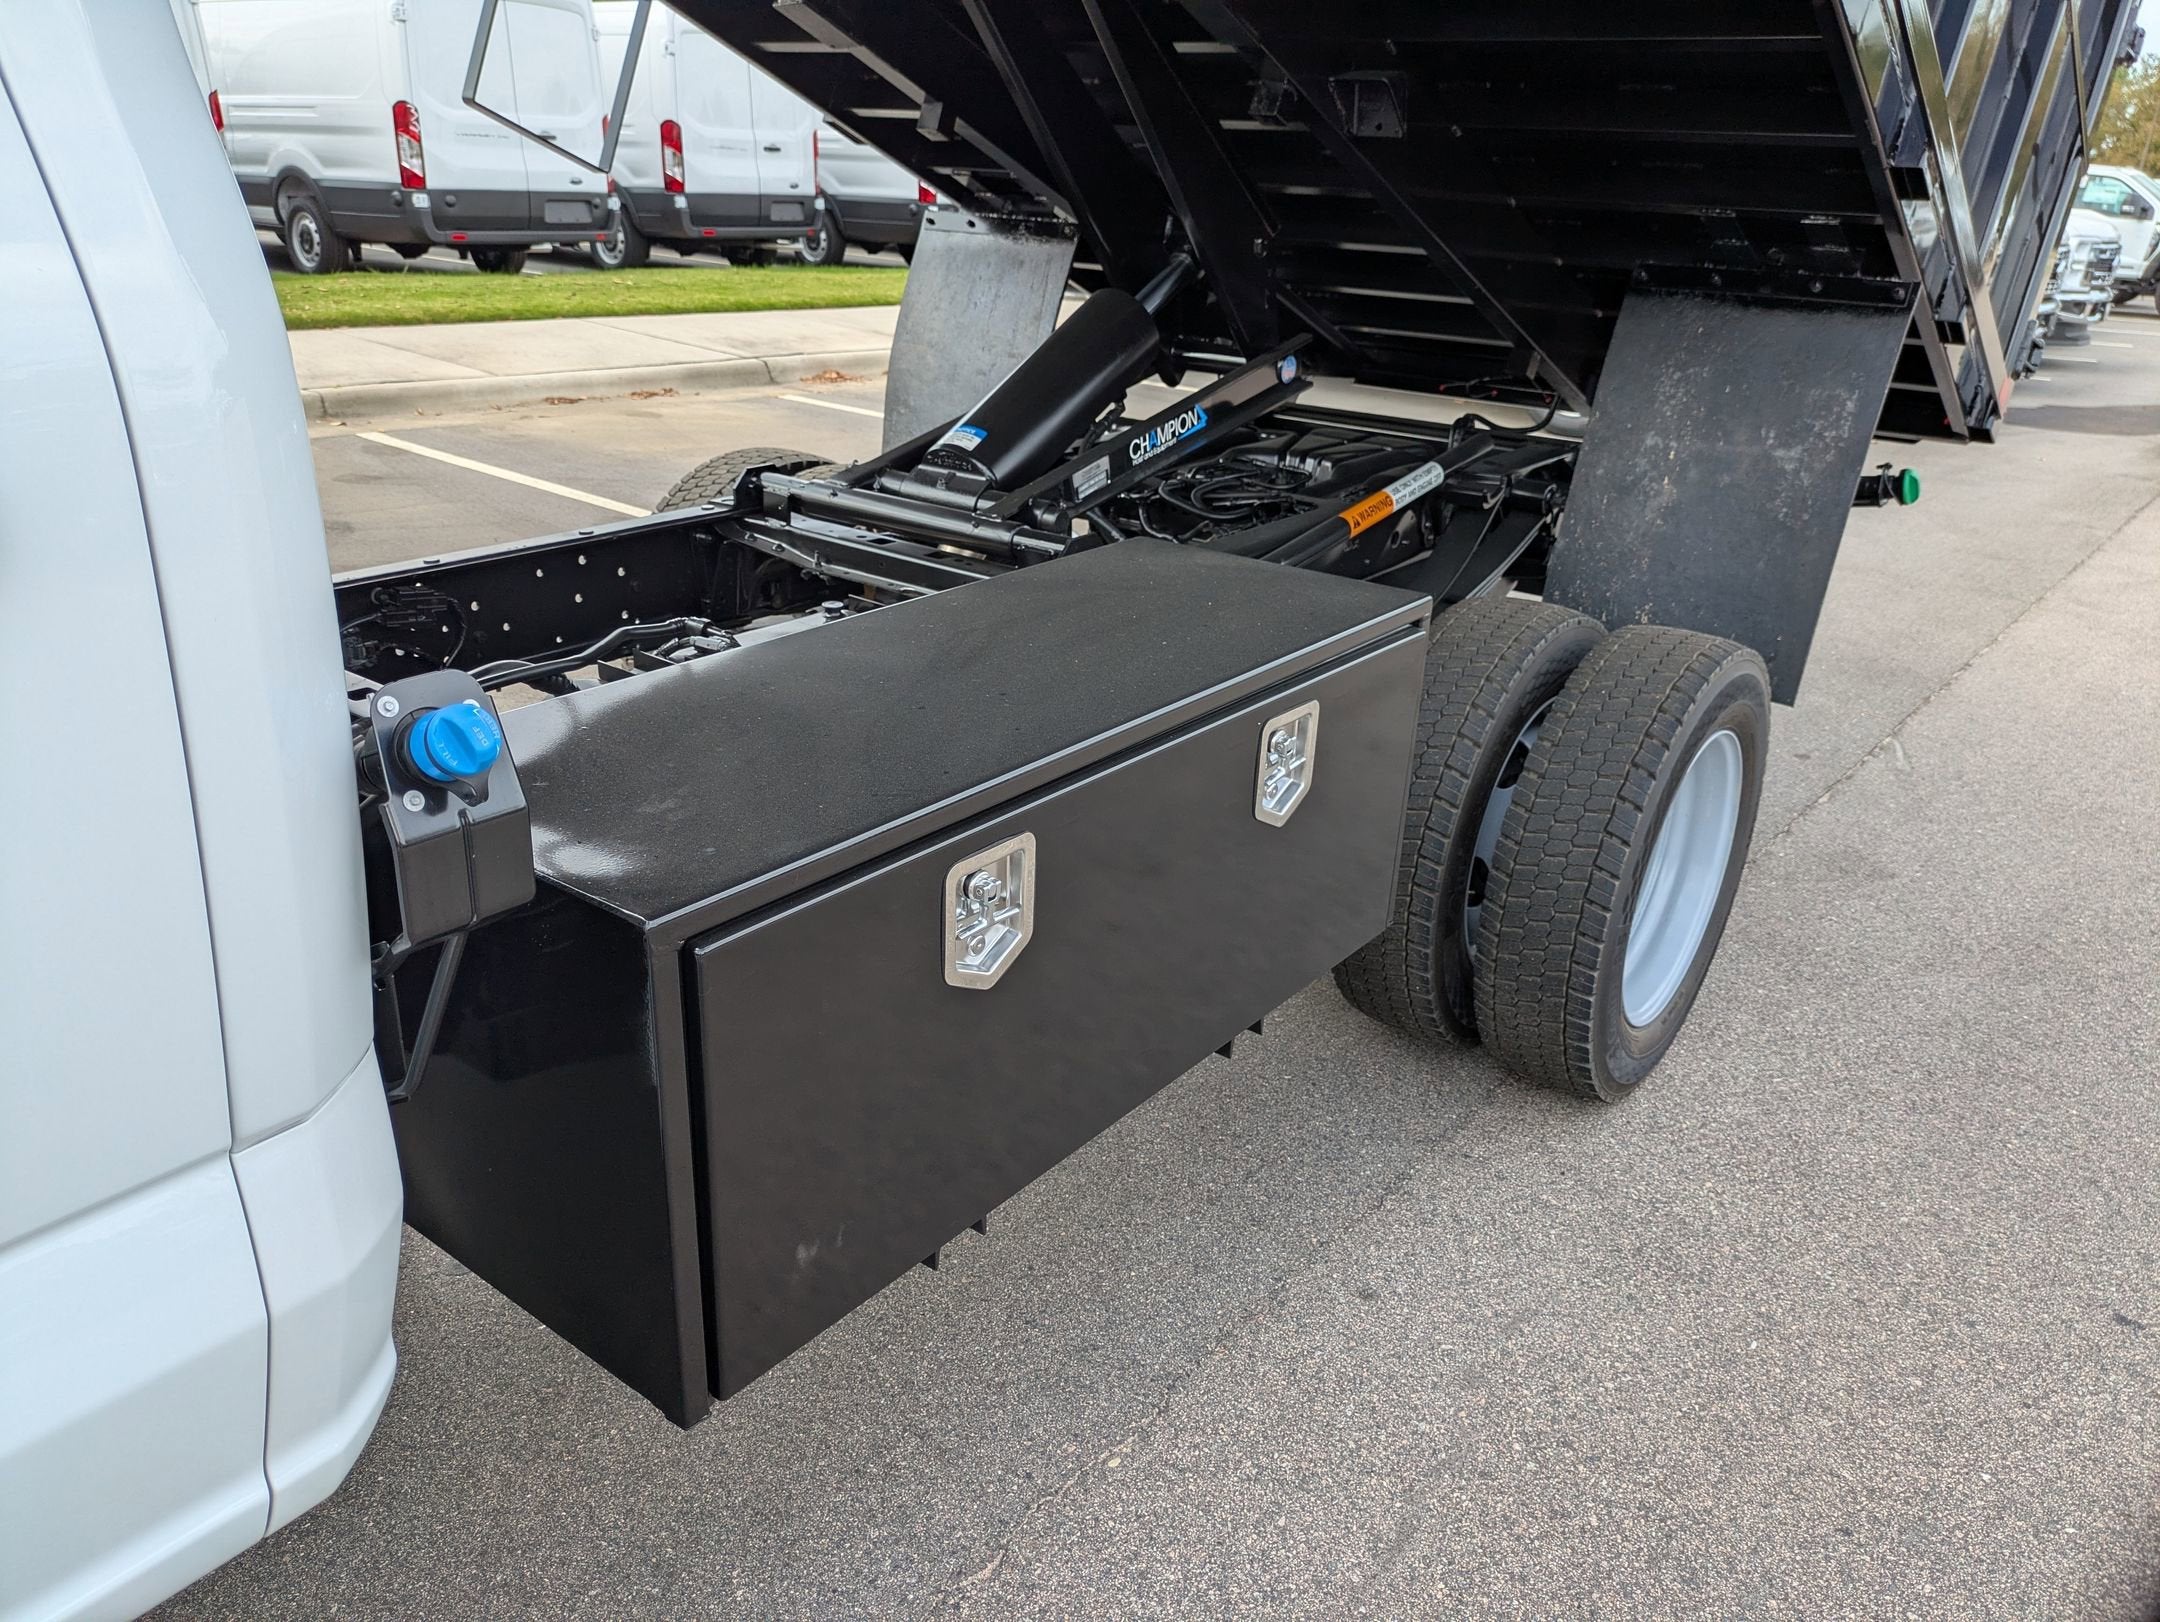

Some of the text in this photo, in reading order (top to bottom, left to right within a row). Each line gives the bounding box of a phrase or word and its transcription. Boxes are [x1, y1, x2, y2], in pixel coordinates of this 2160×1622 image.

[1129, 408, 1199, 460] CHAMPION
[1359, 495, 1393, 522] WARNING
[472, 726, 489, 747] DEF
